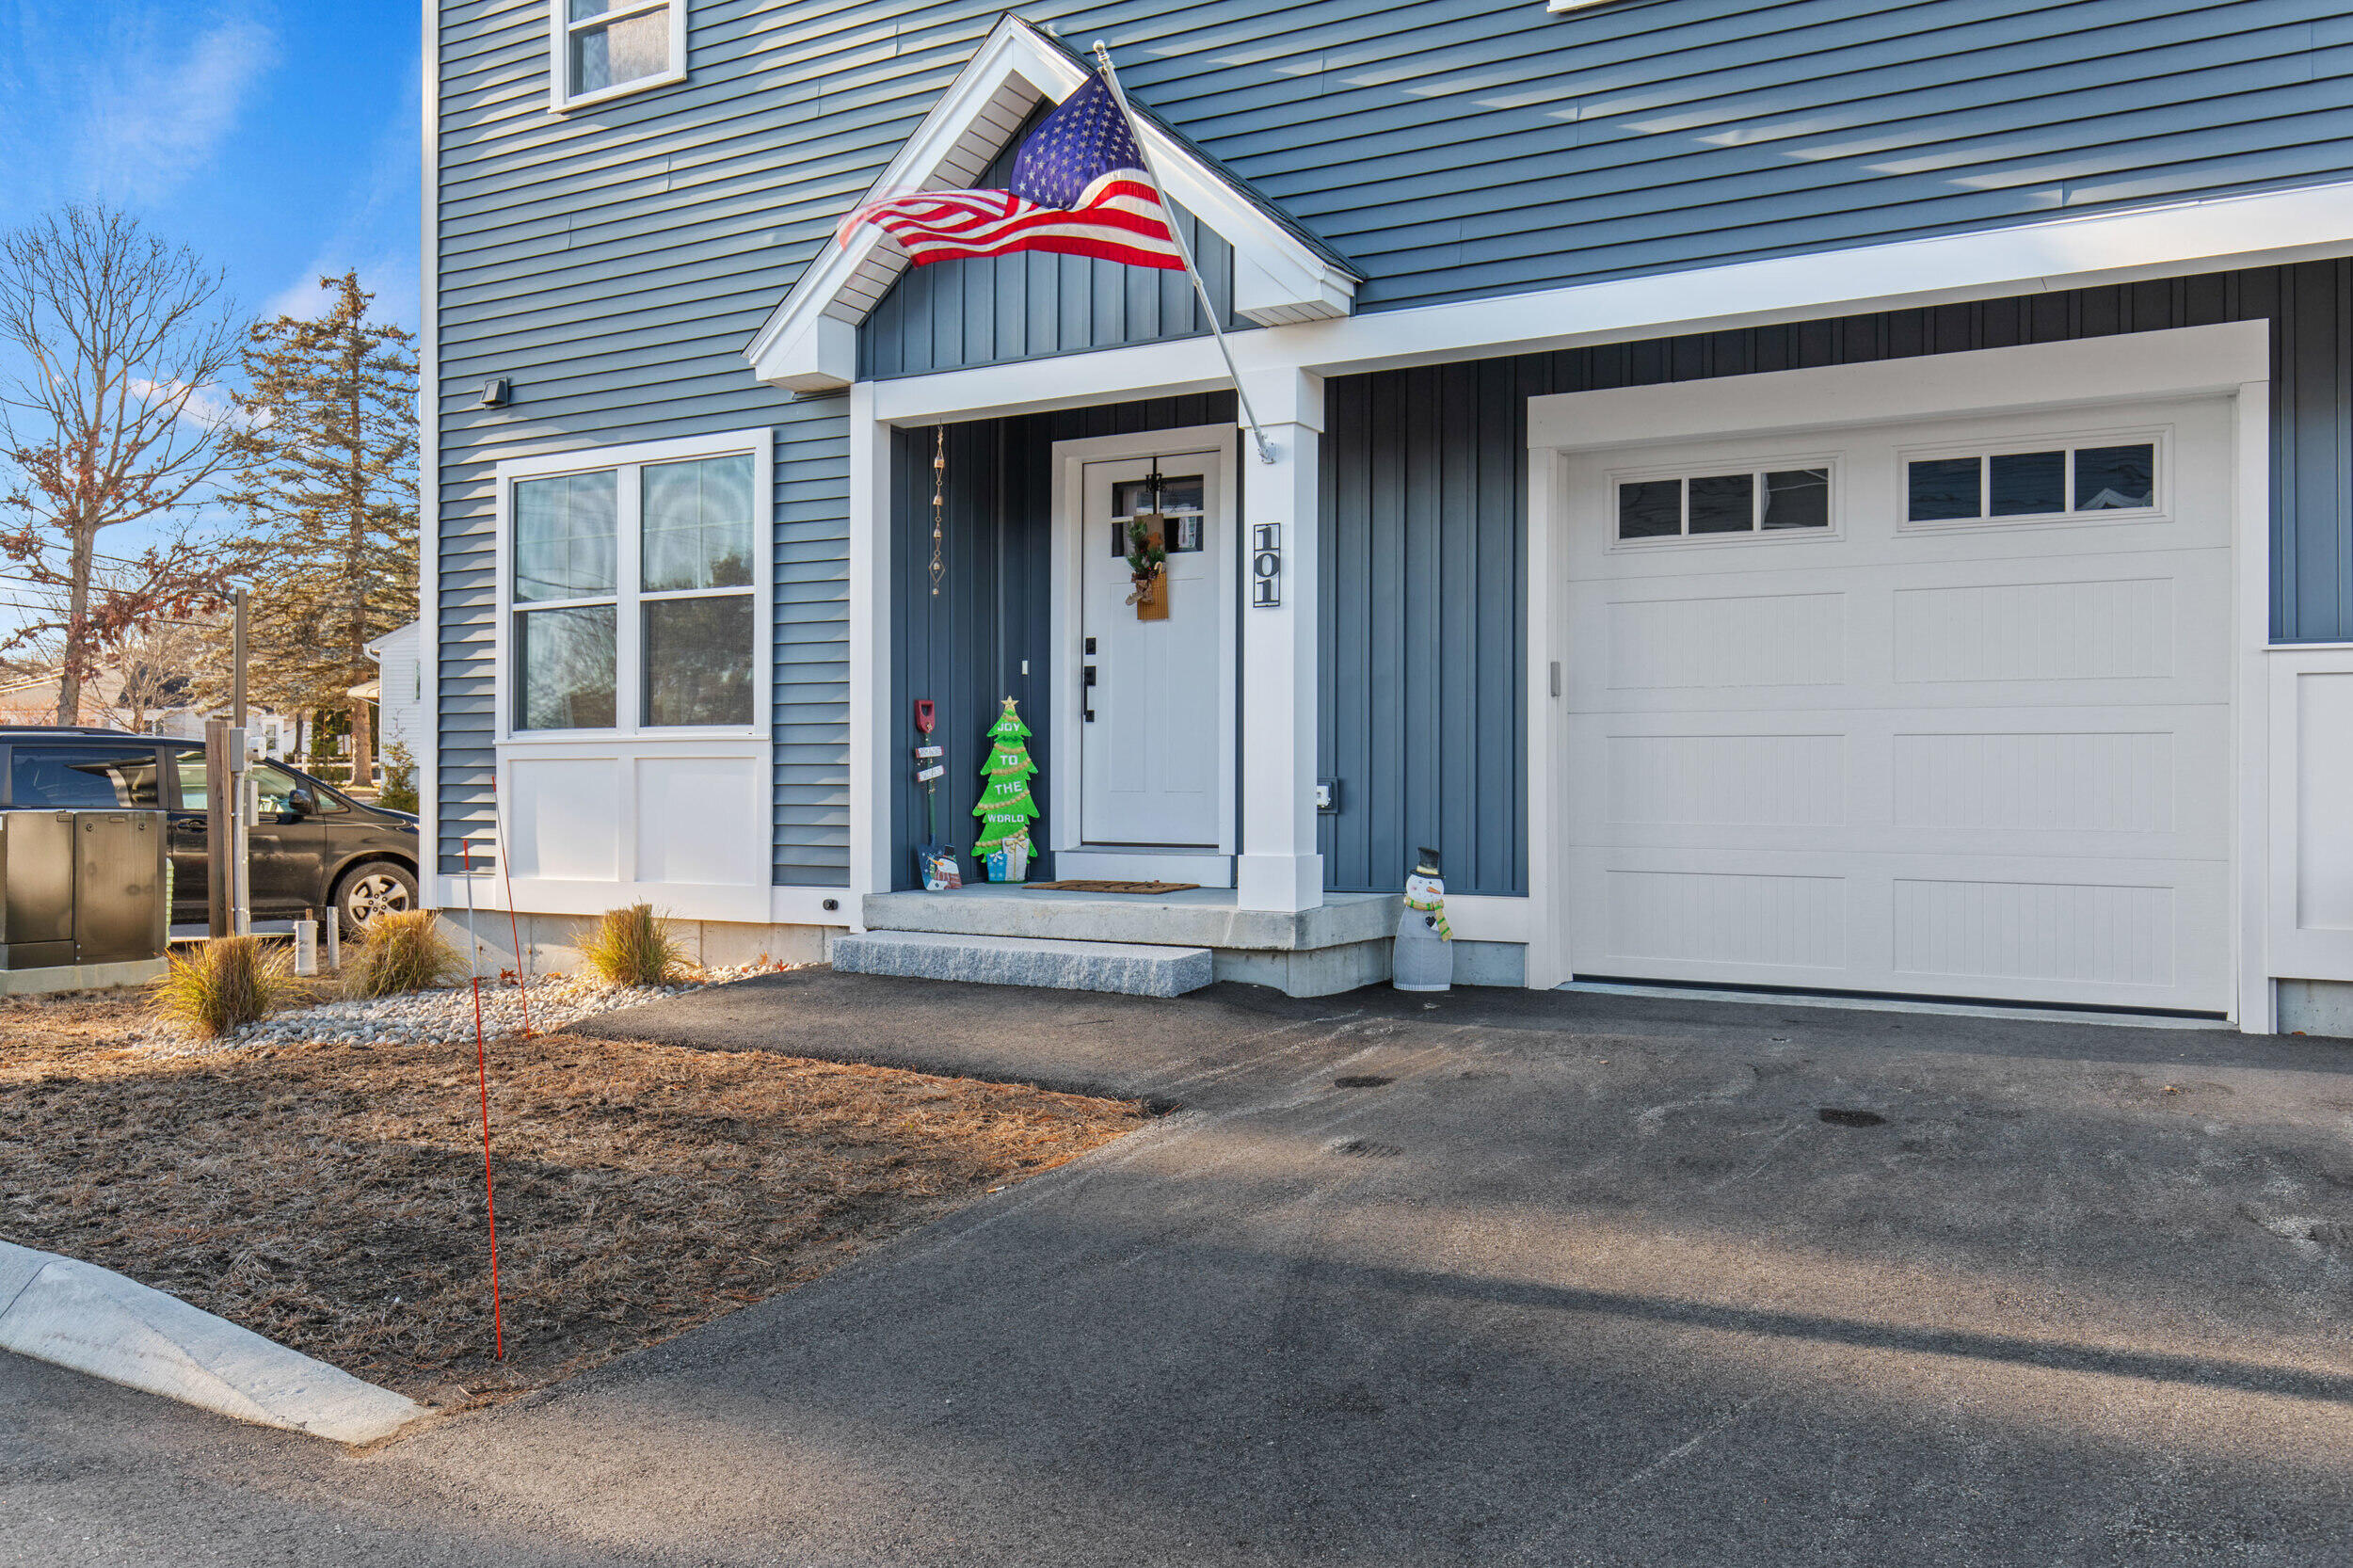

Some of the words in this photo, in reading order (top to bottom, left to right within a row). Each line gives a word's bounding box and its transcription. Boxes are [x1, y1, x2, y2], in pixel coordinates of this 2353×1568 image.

[1255, 526, 1280, 603] 101
[998, 723, 1019, 731] JOY
[1000, 755, 1017, 765] TO
[995, 781, 1022, 795] THE
[988, 814, 1024, 823] WORLD
